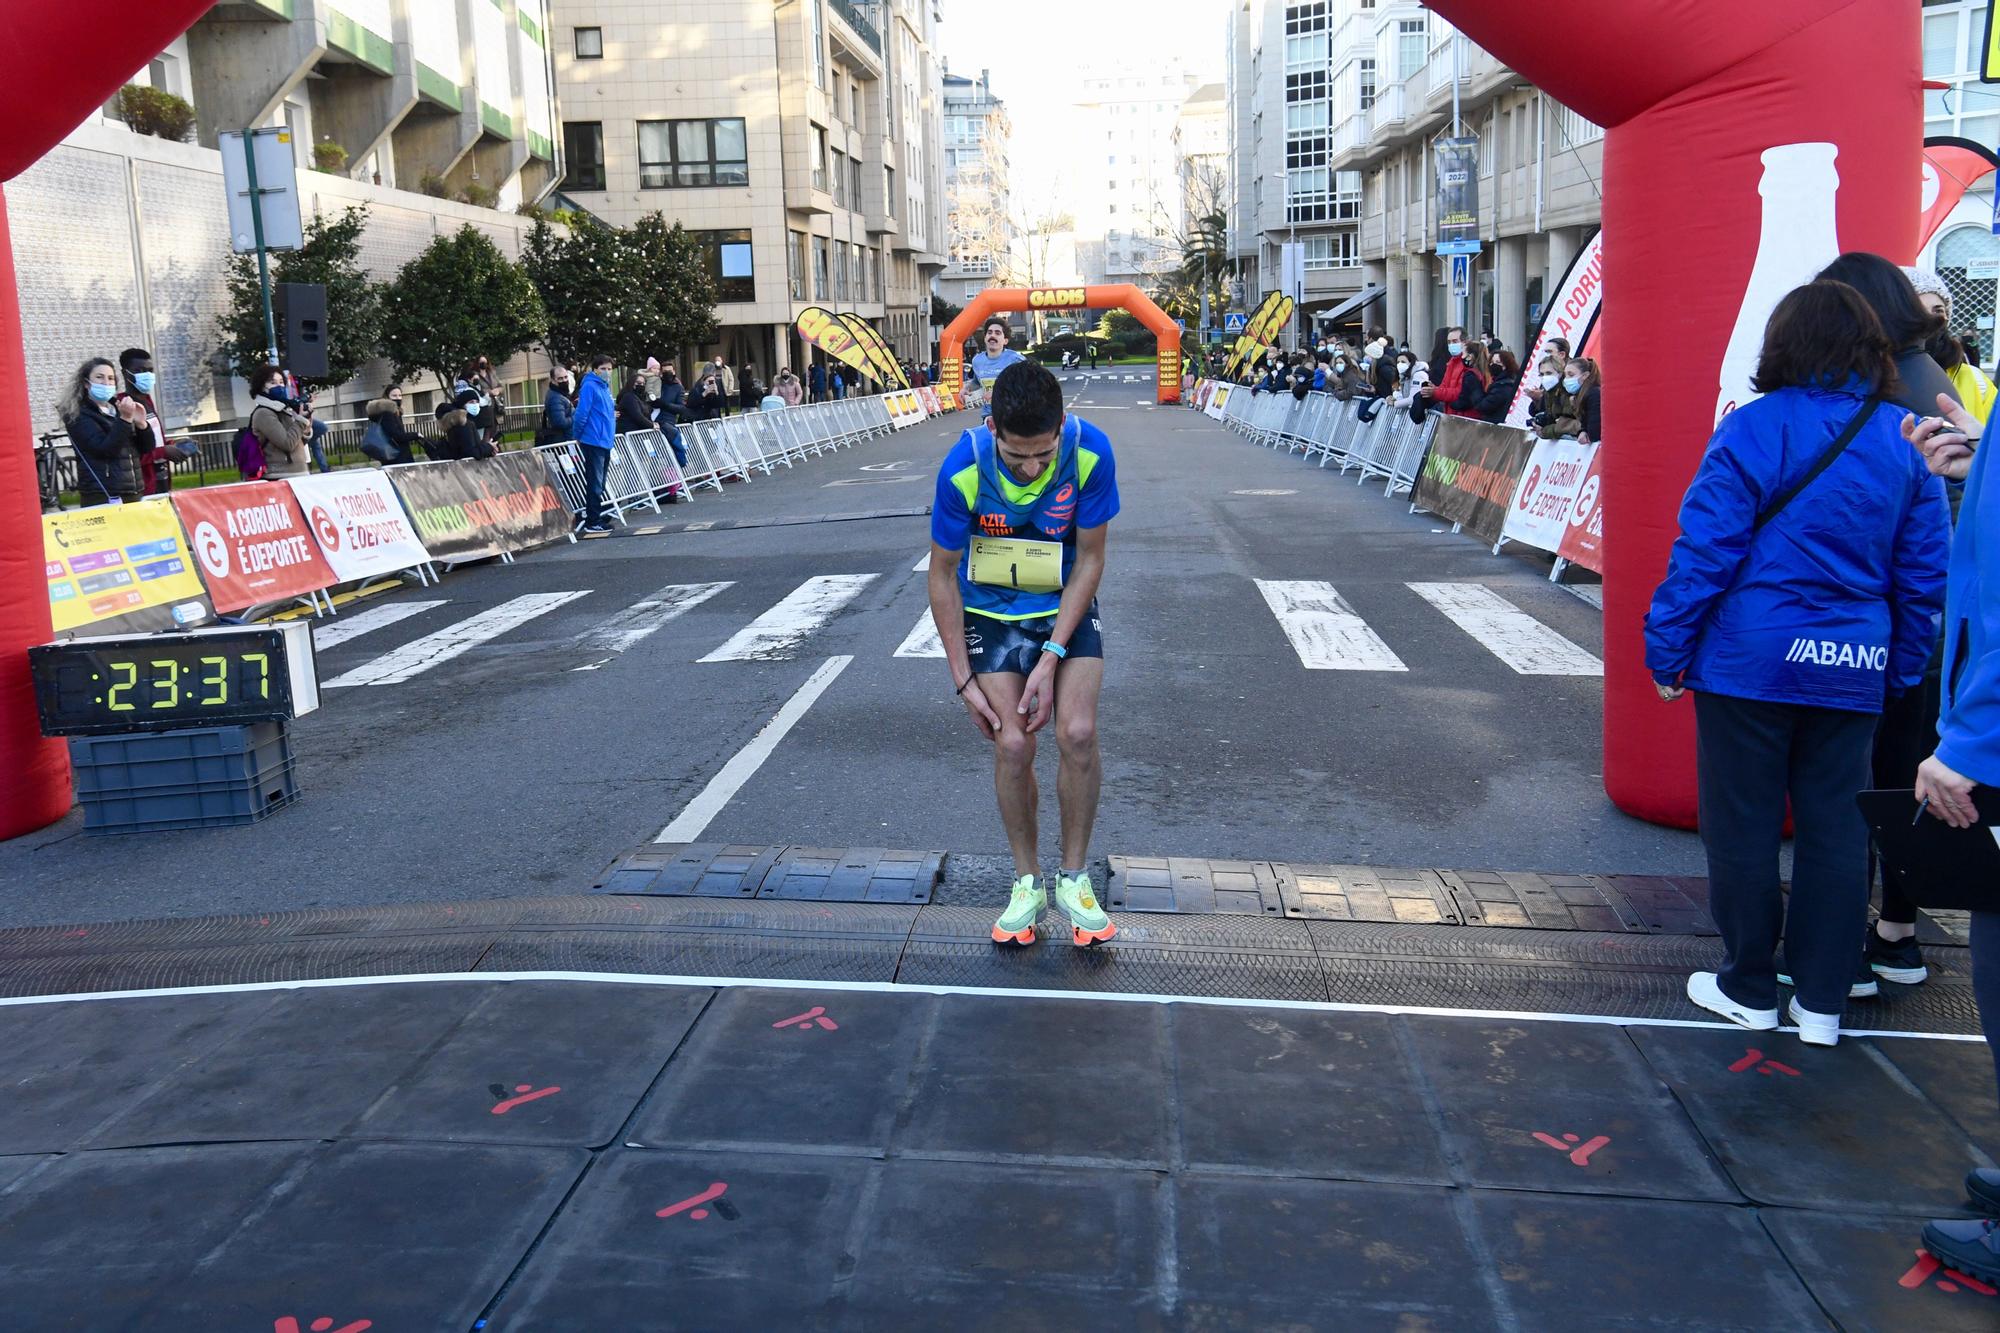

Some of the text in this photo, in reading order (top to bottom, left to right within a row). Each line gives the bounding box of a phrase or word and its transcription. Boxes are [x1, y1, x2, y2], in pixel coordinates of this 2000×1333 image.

[1029, 288, 1086, 306] GADIS
[1556, 317, 1572, 339] A
[343, 488, 387, 518] CORUÑA
[226, 498, 293, 538] A CORUÑA
[979, 513, 1007, 528] AZIZ
[357, 519, 407, 548] DEPORTE
[237, 535, 312, 574] É DEPORTE
[1010, 563, 1018, 587] 1
